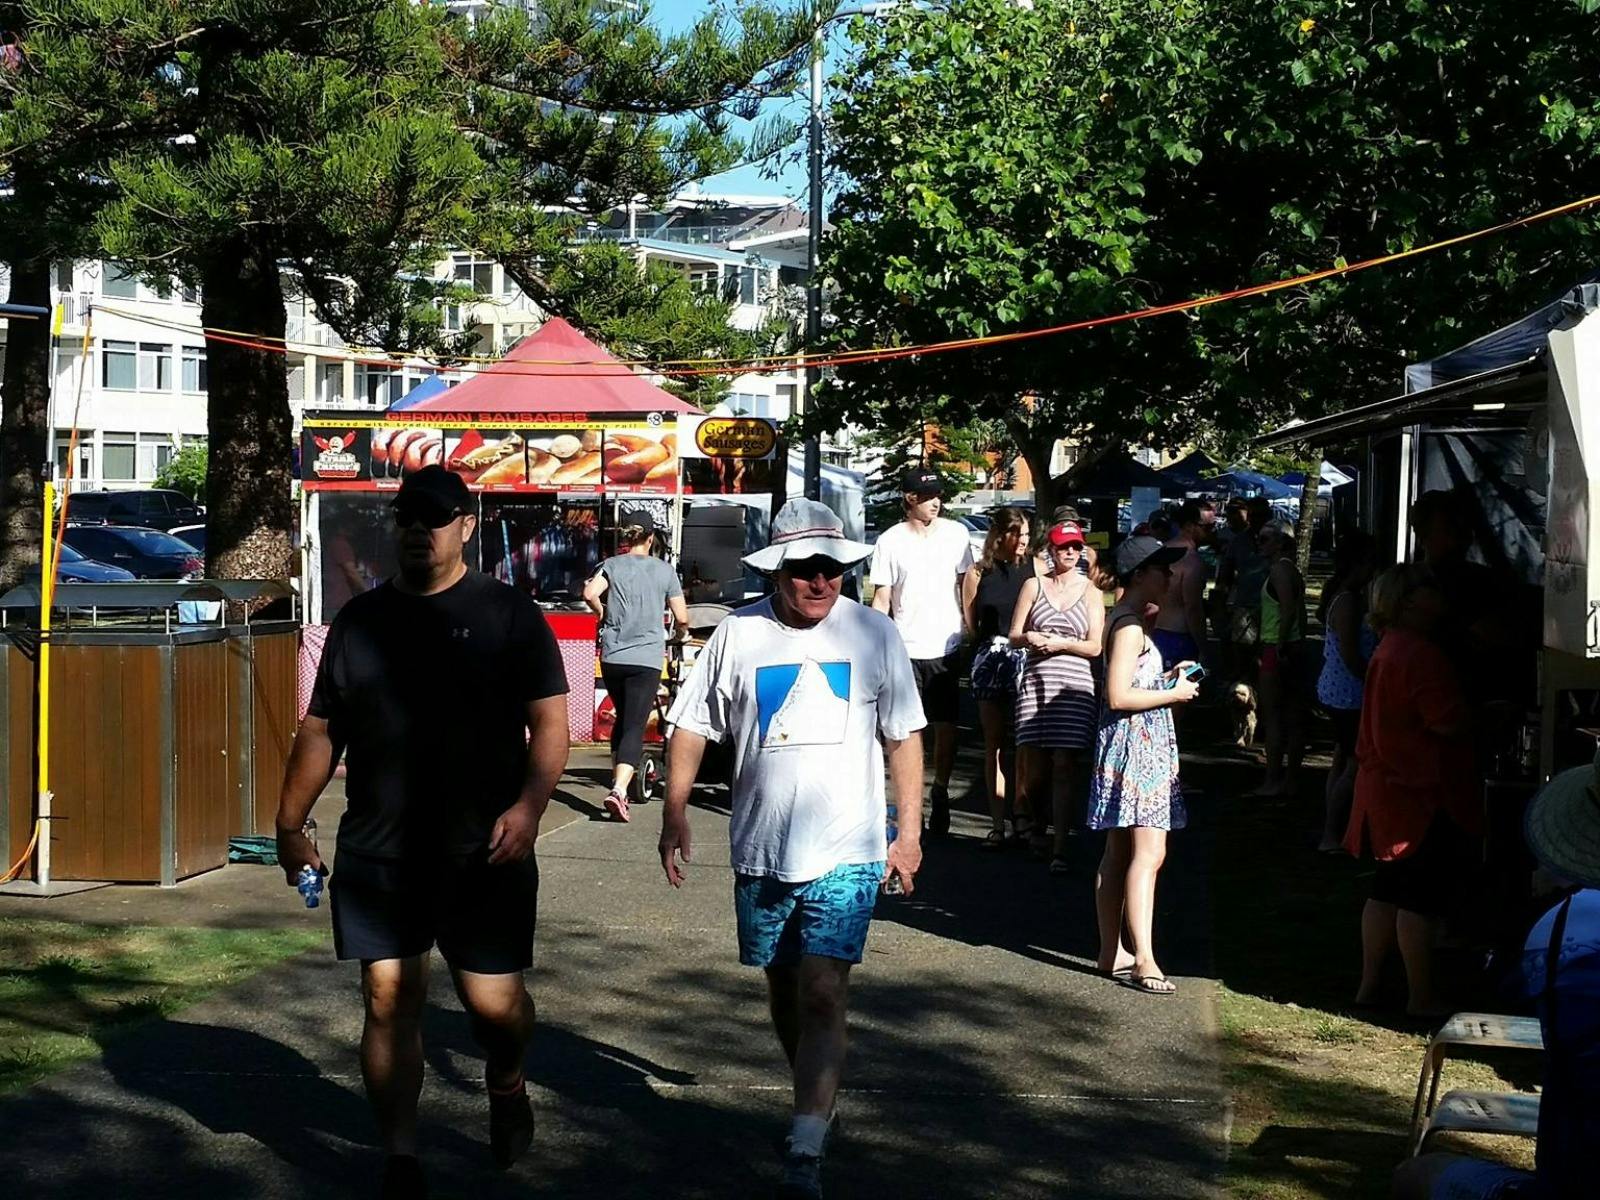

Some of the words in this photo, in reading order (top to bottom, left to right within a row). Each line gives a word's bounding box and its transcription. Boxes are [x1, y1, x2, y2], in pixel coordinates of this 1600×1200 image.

[385, 412, 472, 422] GERMAN
[478, 412, 588, 423] SAUSAGES
[704, 422, 765, 436] German
[703, 435, 766, 452] Sausages
